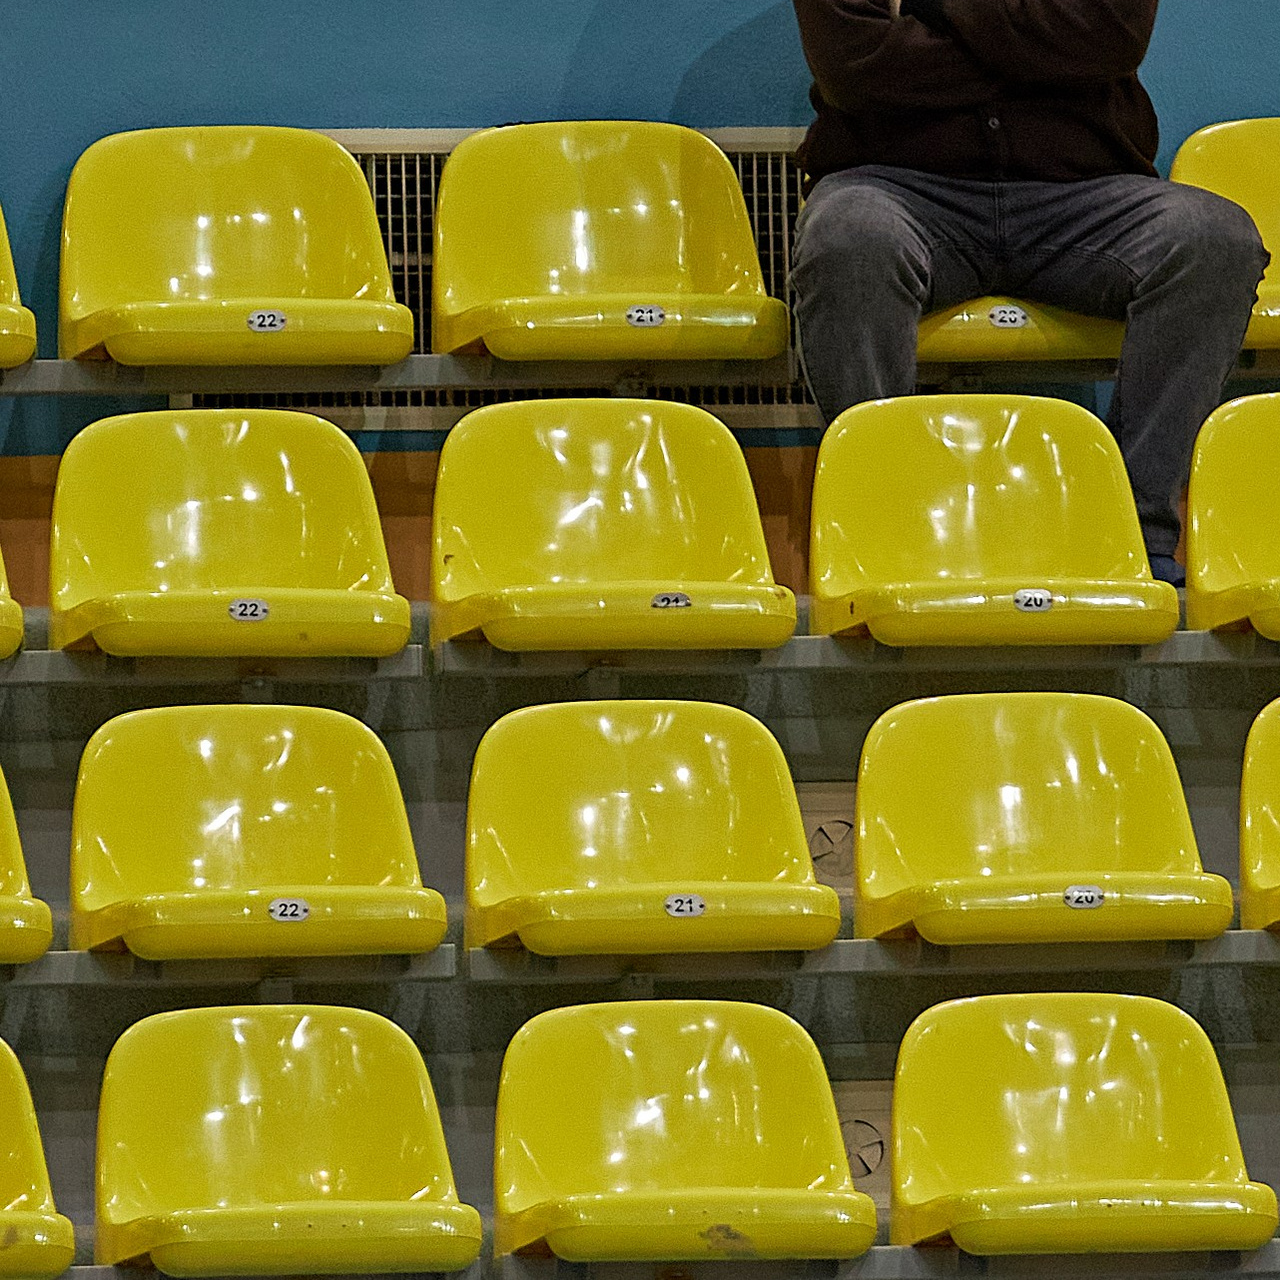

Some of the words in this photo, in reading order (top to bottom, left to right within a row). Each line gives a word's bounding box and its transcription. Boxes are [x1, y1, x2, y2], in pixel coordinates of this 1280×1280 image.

[257, 314, 276, 327] 22
[636, 309, 653, 322] 21
[239, 604, 258, 616] 22
[279, 904, 298, 916] 22
[675, 899, 692, 912] 21
